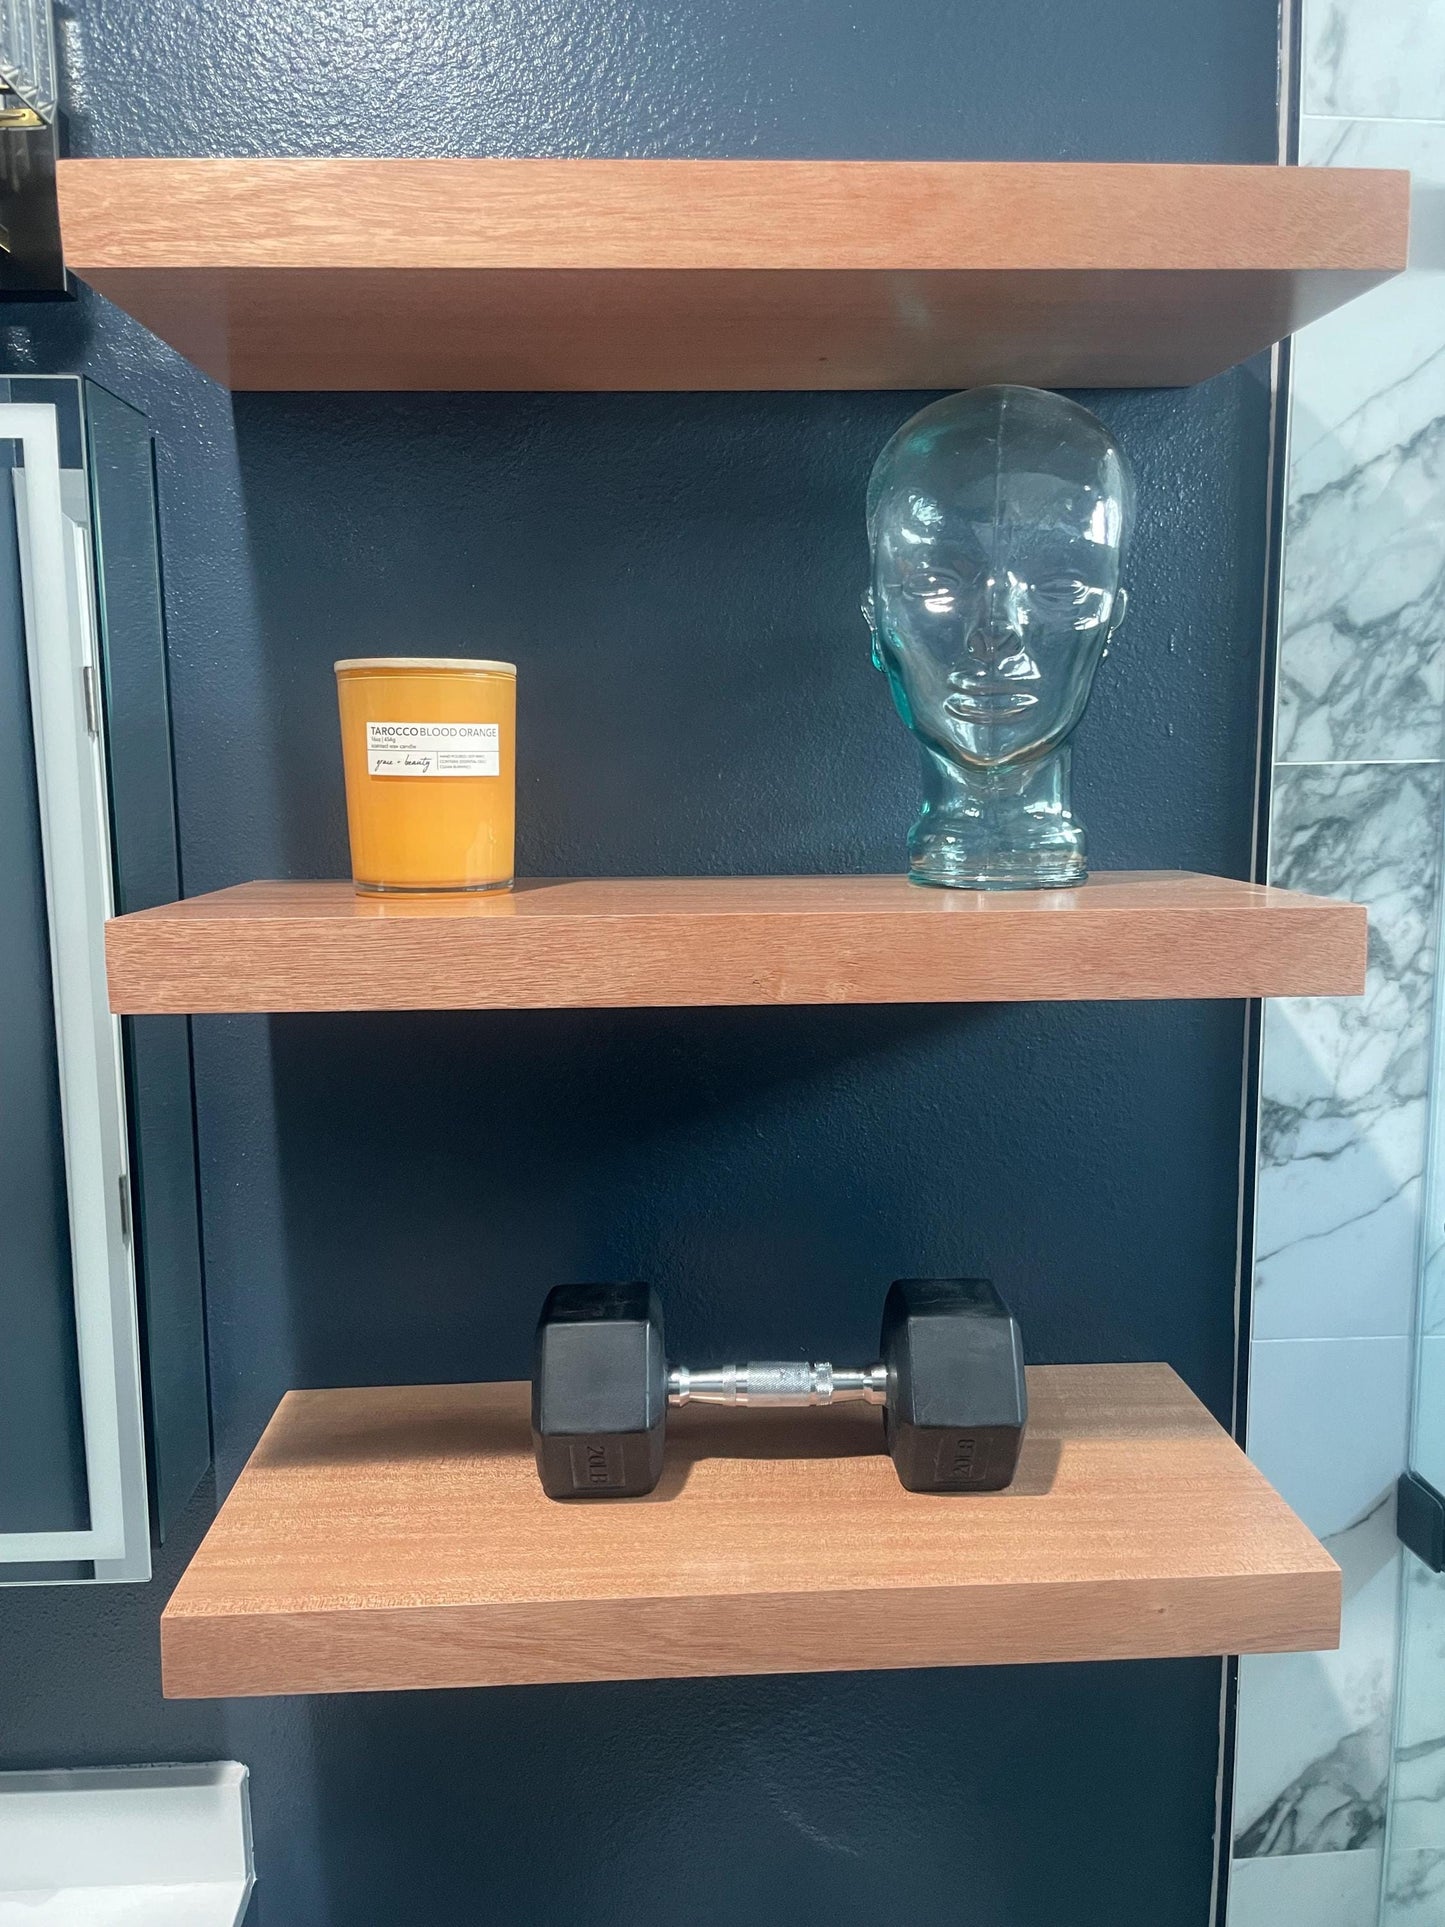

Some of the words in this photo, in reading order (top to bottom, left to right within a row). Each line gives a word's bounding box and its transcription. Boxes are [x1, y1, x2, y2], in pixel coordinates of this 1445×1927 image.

[371, 726, 418, 736] TAROCCO
[420, 727, 457, 737] BLOOD
[459, 728, 497, 737] ORANGE
[404, 754, 432, 773] beauty
[587, 1446, 608, 1484] 20LB
